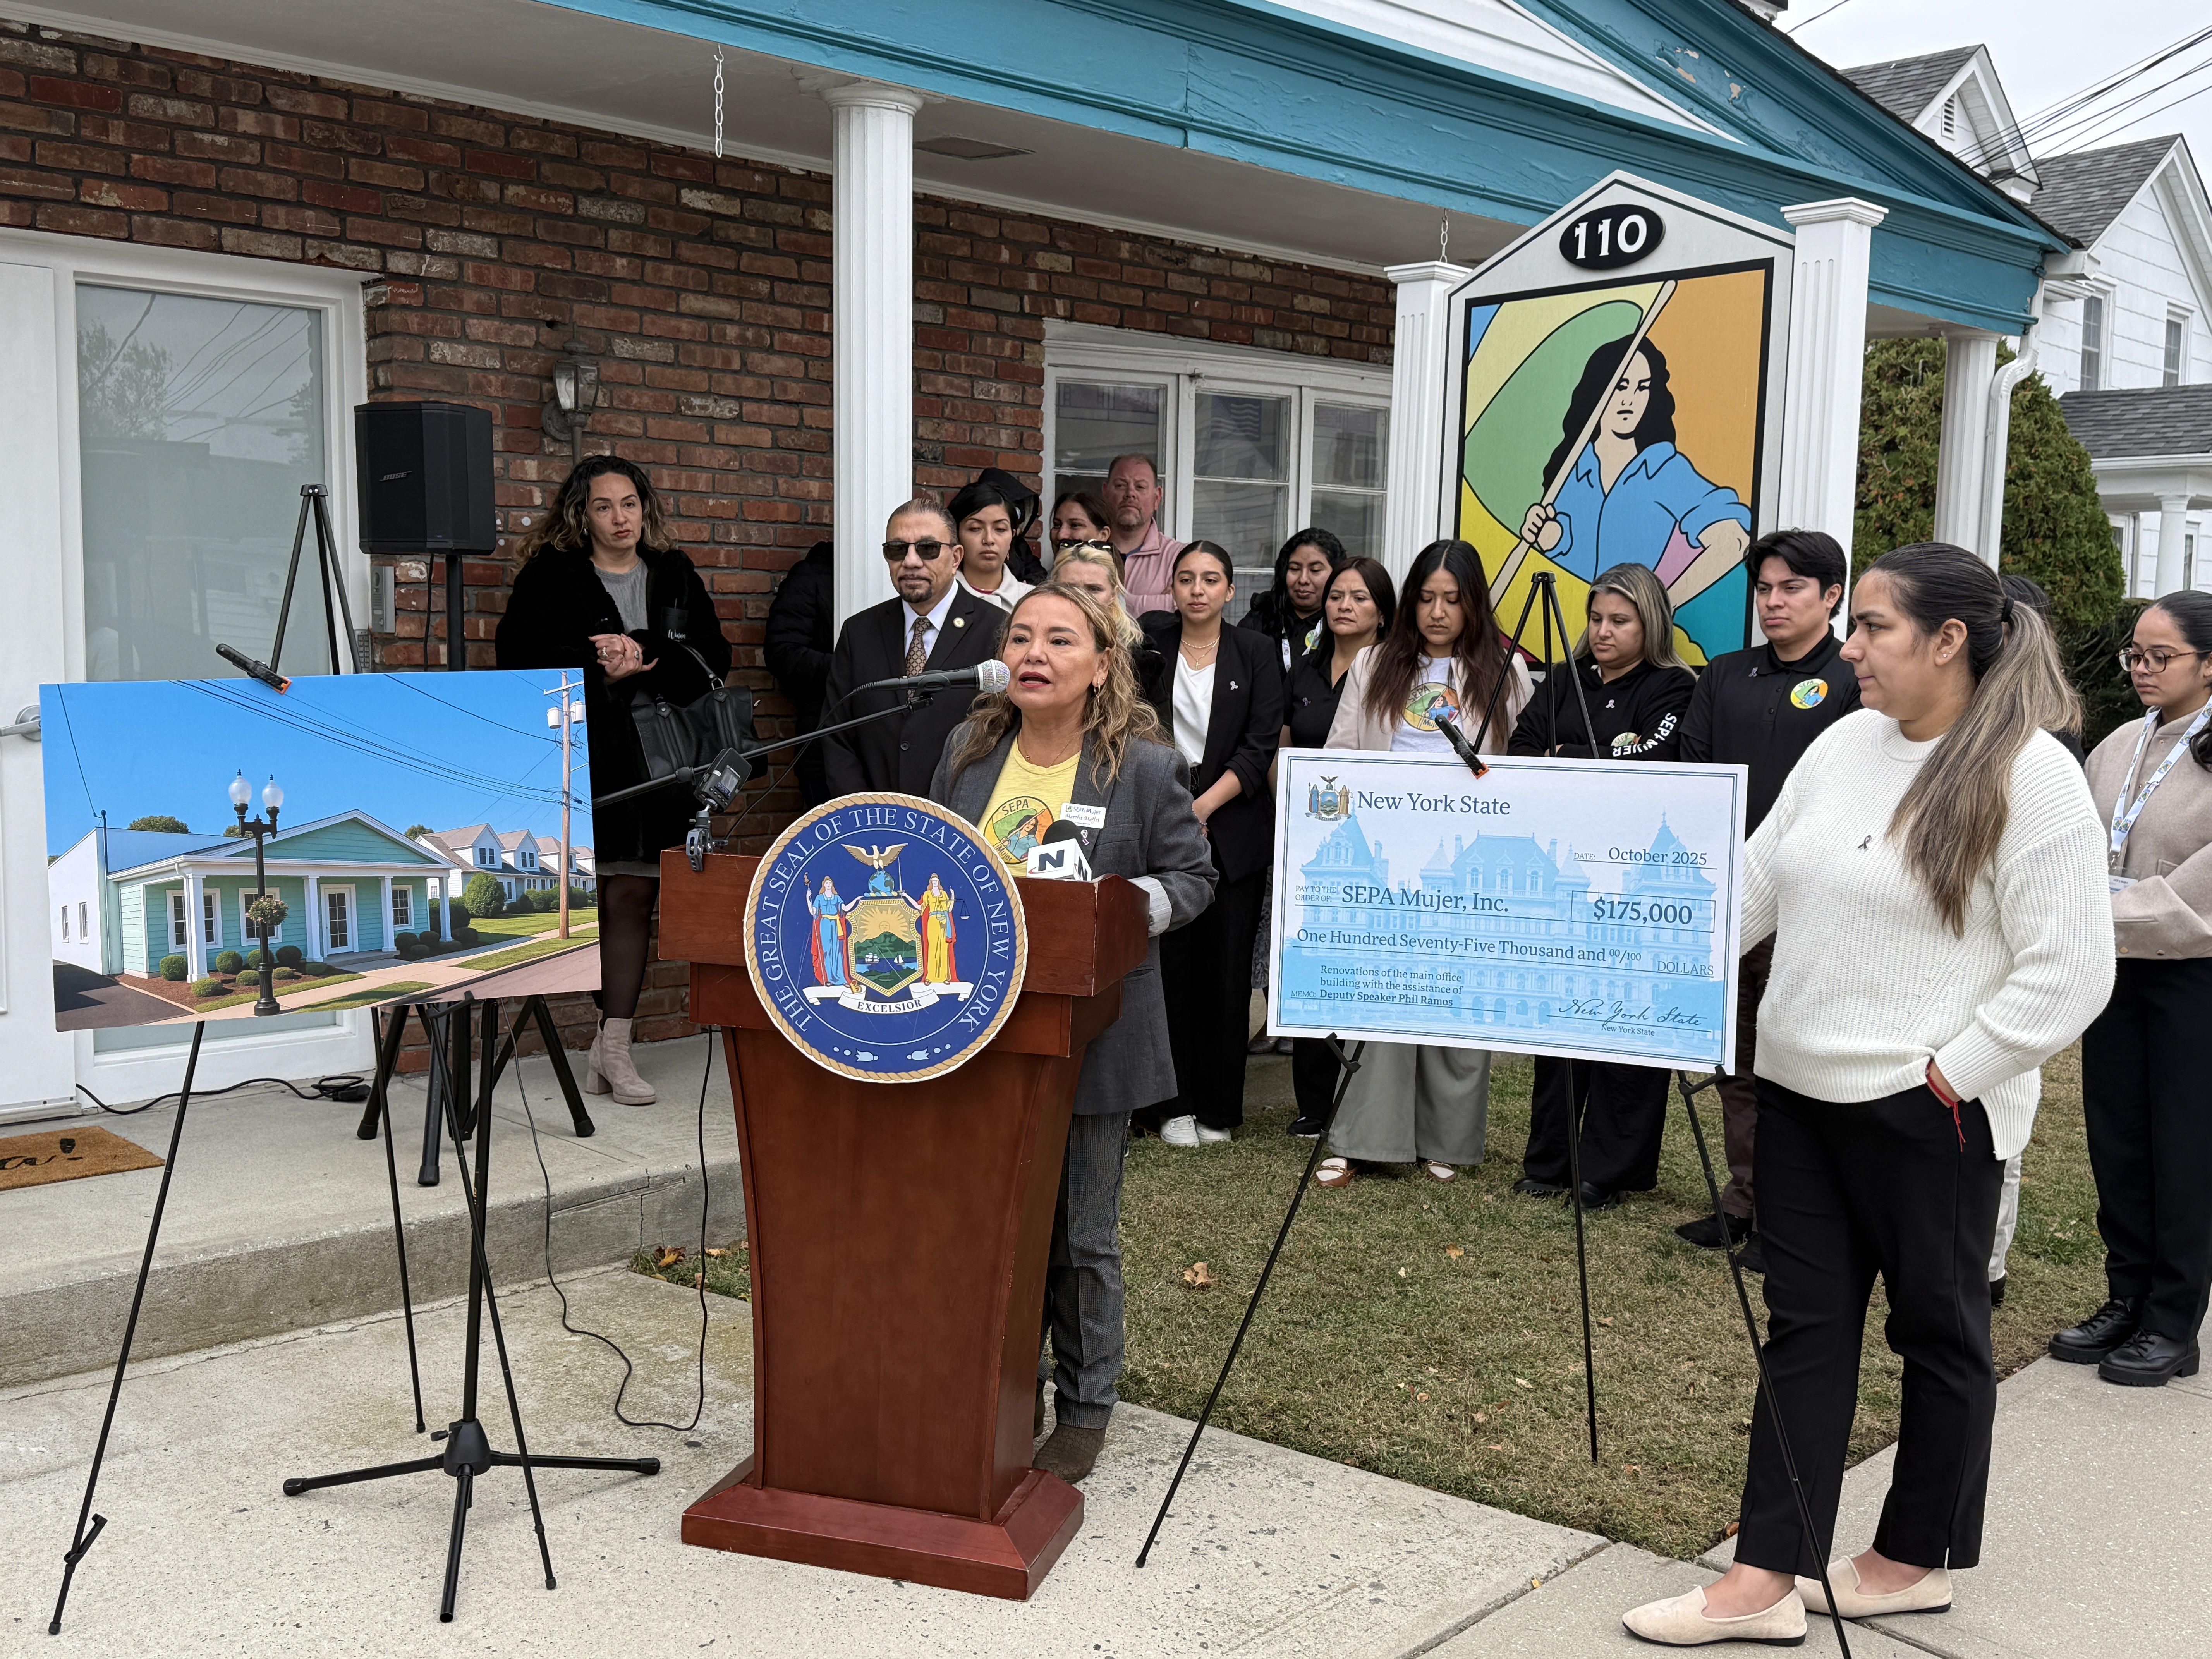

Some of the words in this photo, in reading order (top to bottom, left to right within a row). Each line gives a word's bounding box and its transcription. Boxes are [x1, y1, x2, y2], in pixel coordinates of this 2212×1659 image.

[1575, 214, 1647, 259] 110
[1408, 685, 1431, 702] SEPA
[1002, 799, 1029, 816] SEPA
[1357, 791, 1403, 809] New
[1407, 793, 1456, 812] York
[1460, 795, 1511, 815] State
[815, 815, 843, 842] OF
[848, 807, 897, 828] THE
[904, 811, 976, 866] STATE
[770, 840, 814, 893] SEAL
[1038, 849, 1065, 871] N
[1574, 852, 1595, 860] DATE:
[1608, 847, 1668, 863] October
[1671, 852, 1707, 865] 2025
[972, 864, 998, 893] OF
[1341, 885, 1395, 905] SEPA
[1400, 888, 1467, 911] Mujer,
[1472, 892, 1508, 912] Inc.
[1594, 896, 1692, 924] $175,000
[760, 896, 783, 981] GREAT
[988, 902, 1010, 960] NEW
[1297, 929, 1326, 943] One
[1330, 930, 1396, 946] Hundred
[1400, 934, 1496, 953] Seventy-Five
[1499, 941, 1574, 959] Thousand
[1577, 948, 1606, 961] and
[1657, 961, 1714, 976] DOLLARS
[1320, 977, 1360, 989] building
[1362, 980, 1383, 989] with
[1385, 981, 1401, 990] the
[1402, 983, 1451, 993] assistance
[1453, 986, 1464, 994] of
[1321, 965, 1379, 977] Renovations
[1381, 969, 1391, 977] of
[1393, 969, 1407, 978] the
[1410, 971, 1434, 980] main
[1436, 972, 1462, 982] office
[857, 998, 922, 1013] EXCELSIOR
[958, 969, 1006, 1033] YORK
[1319, 989, 1355, 1000] Deputy
[1357, 991, 1396, 1002] Speaker
[1399, 994, 1419, 1004] Phil
[1420, 995, 1453, 1006] Ramos
[775, 990, 811, 1032] THE
[1559, 999, 1604, 1015] New
[1602, 1001, 1650, 1025] York
[1657, 1007, 1708, 1025] State
[1601, 1024, 1617, 1032] New
[1637, 1028, 1655, 1036] State
